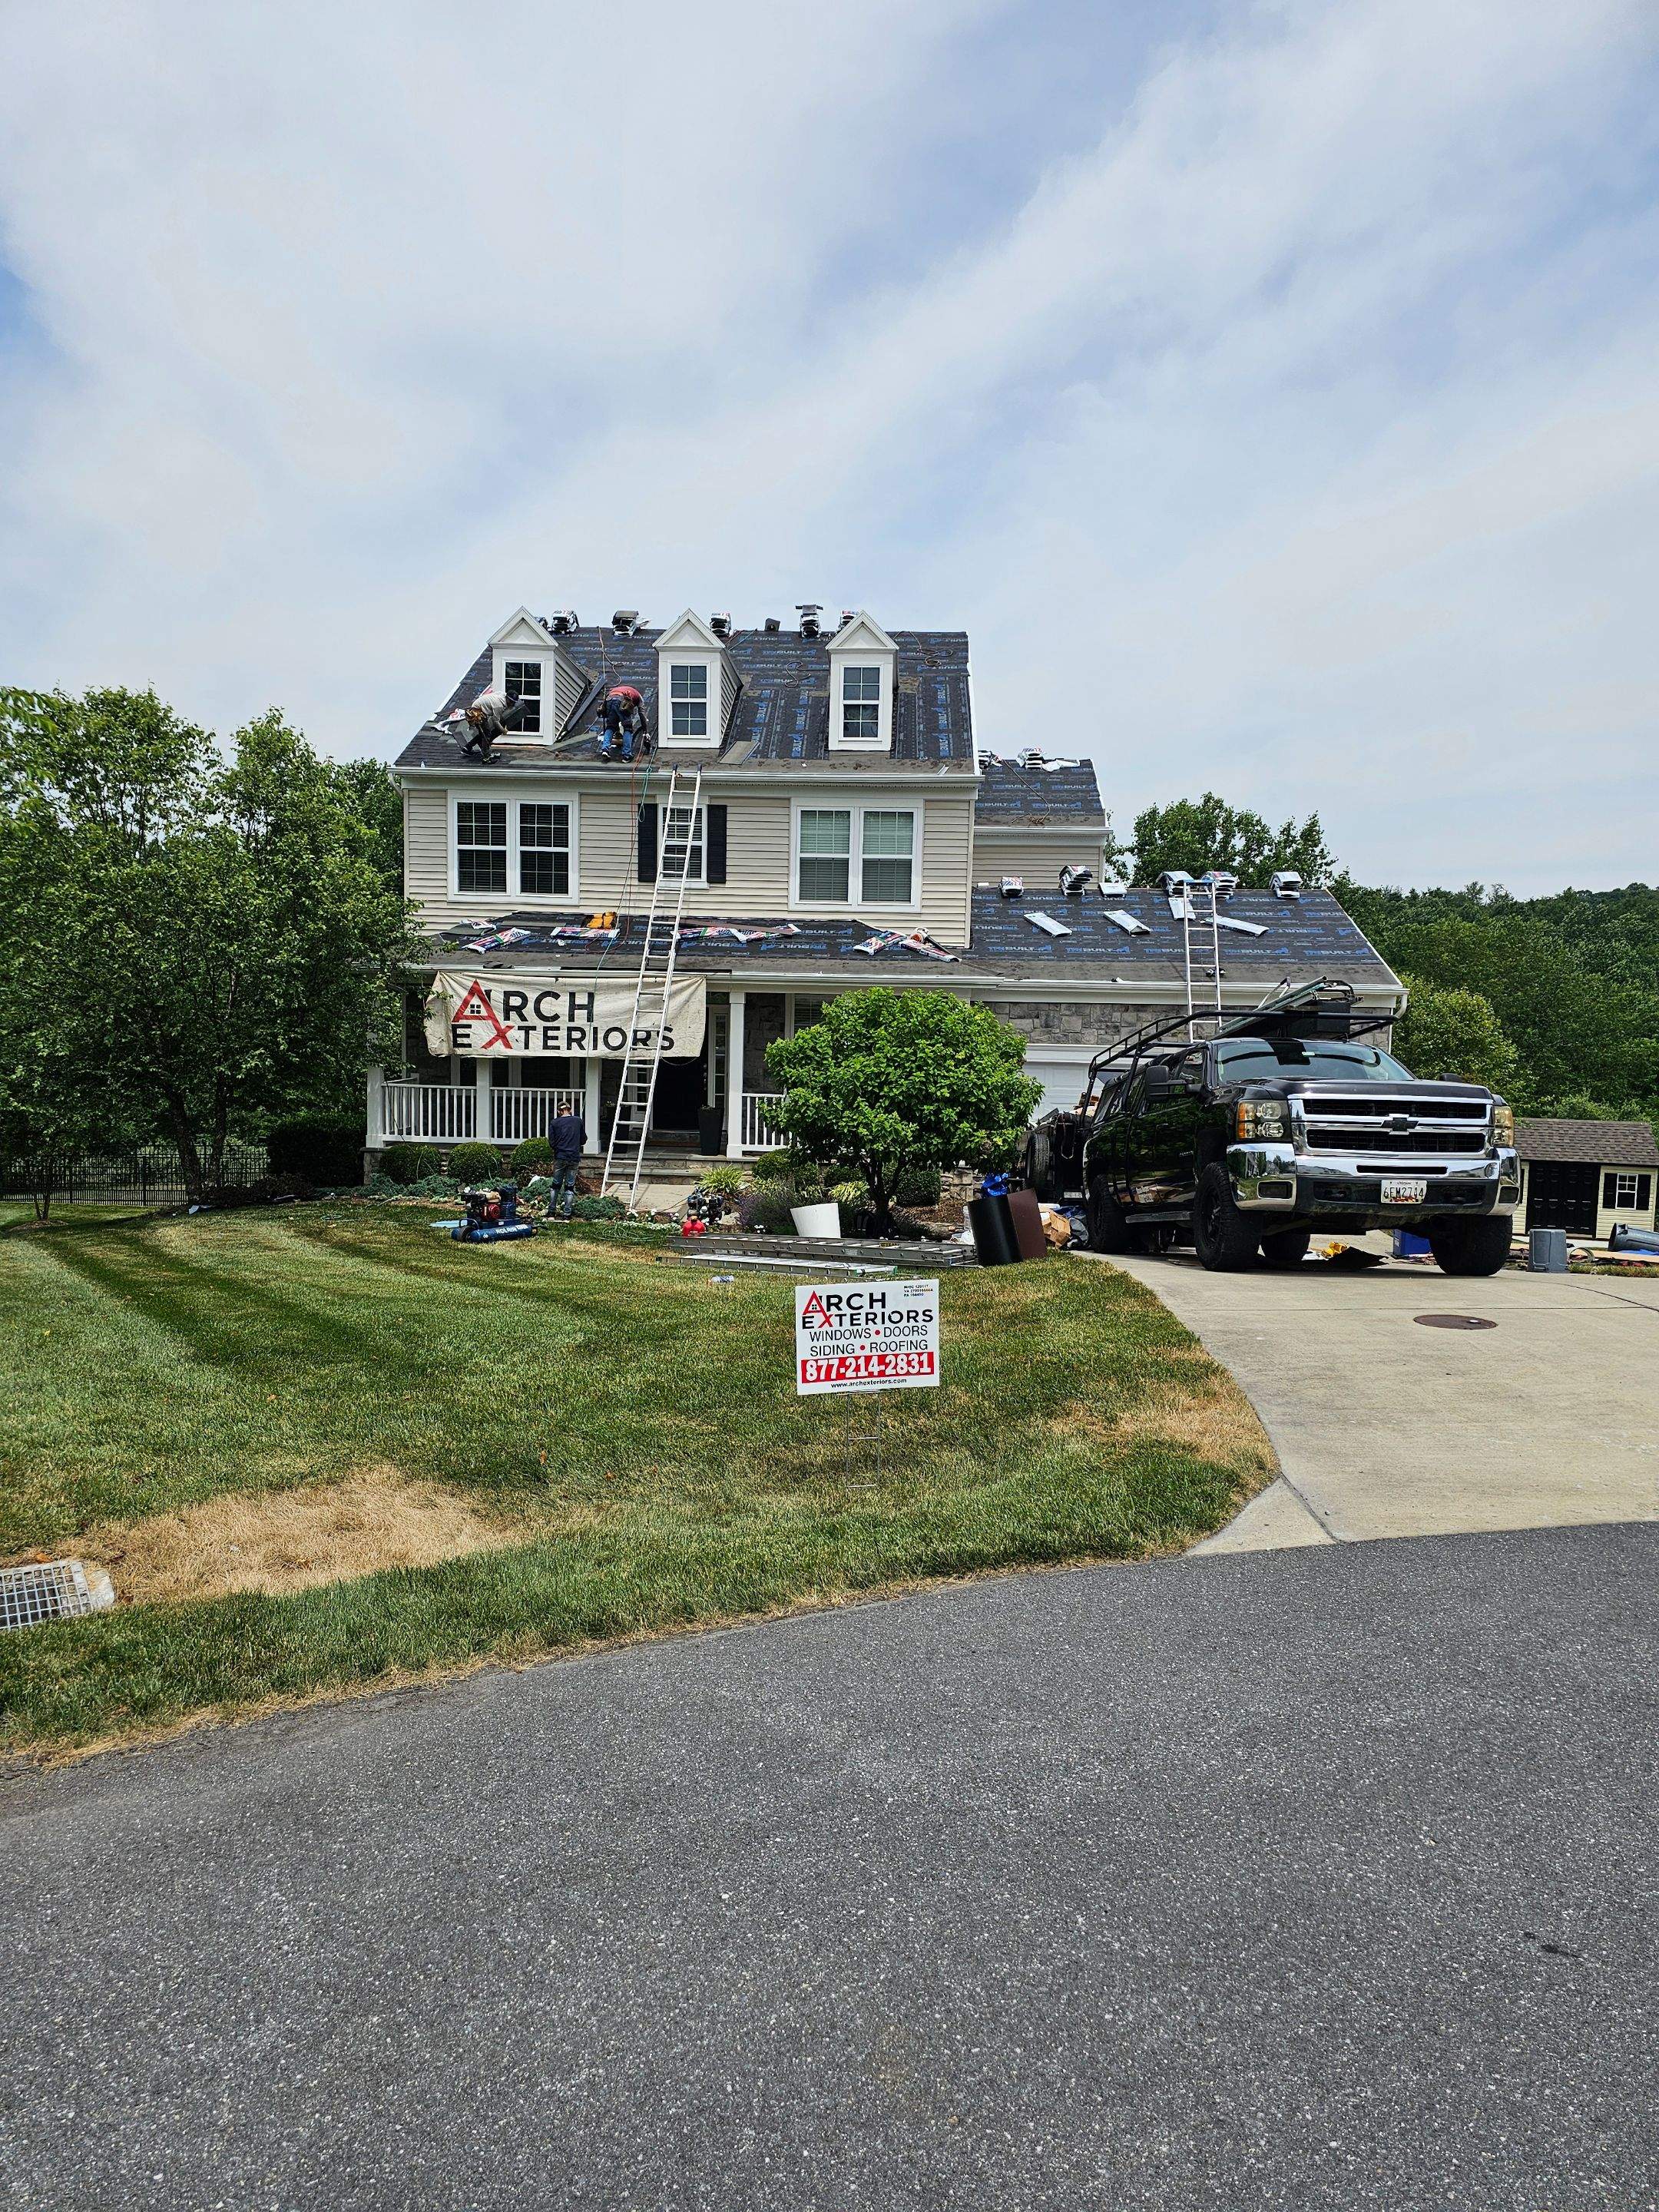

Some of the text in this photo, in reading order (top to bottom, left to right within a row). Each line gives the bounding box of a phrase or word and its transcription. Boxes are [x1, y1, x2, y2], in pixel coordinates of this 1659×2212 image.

[452, 979, 595, 1024] ARCH
[452, 1023, 675, 1051] EXTERIORS
[803, 1290, 886, 1316] ARCH
[802, 1309, 934, 1330] EXTERIORS
[810, 1325, 928, 1343] WINDOWS DOORS
[810, 1339, 928, 1357] SIDING ROOFING
[806, 1353, 932, 1382] 877-214-2831
[830, 1378, 907, 1389] www.archexteriors.com
